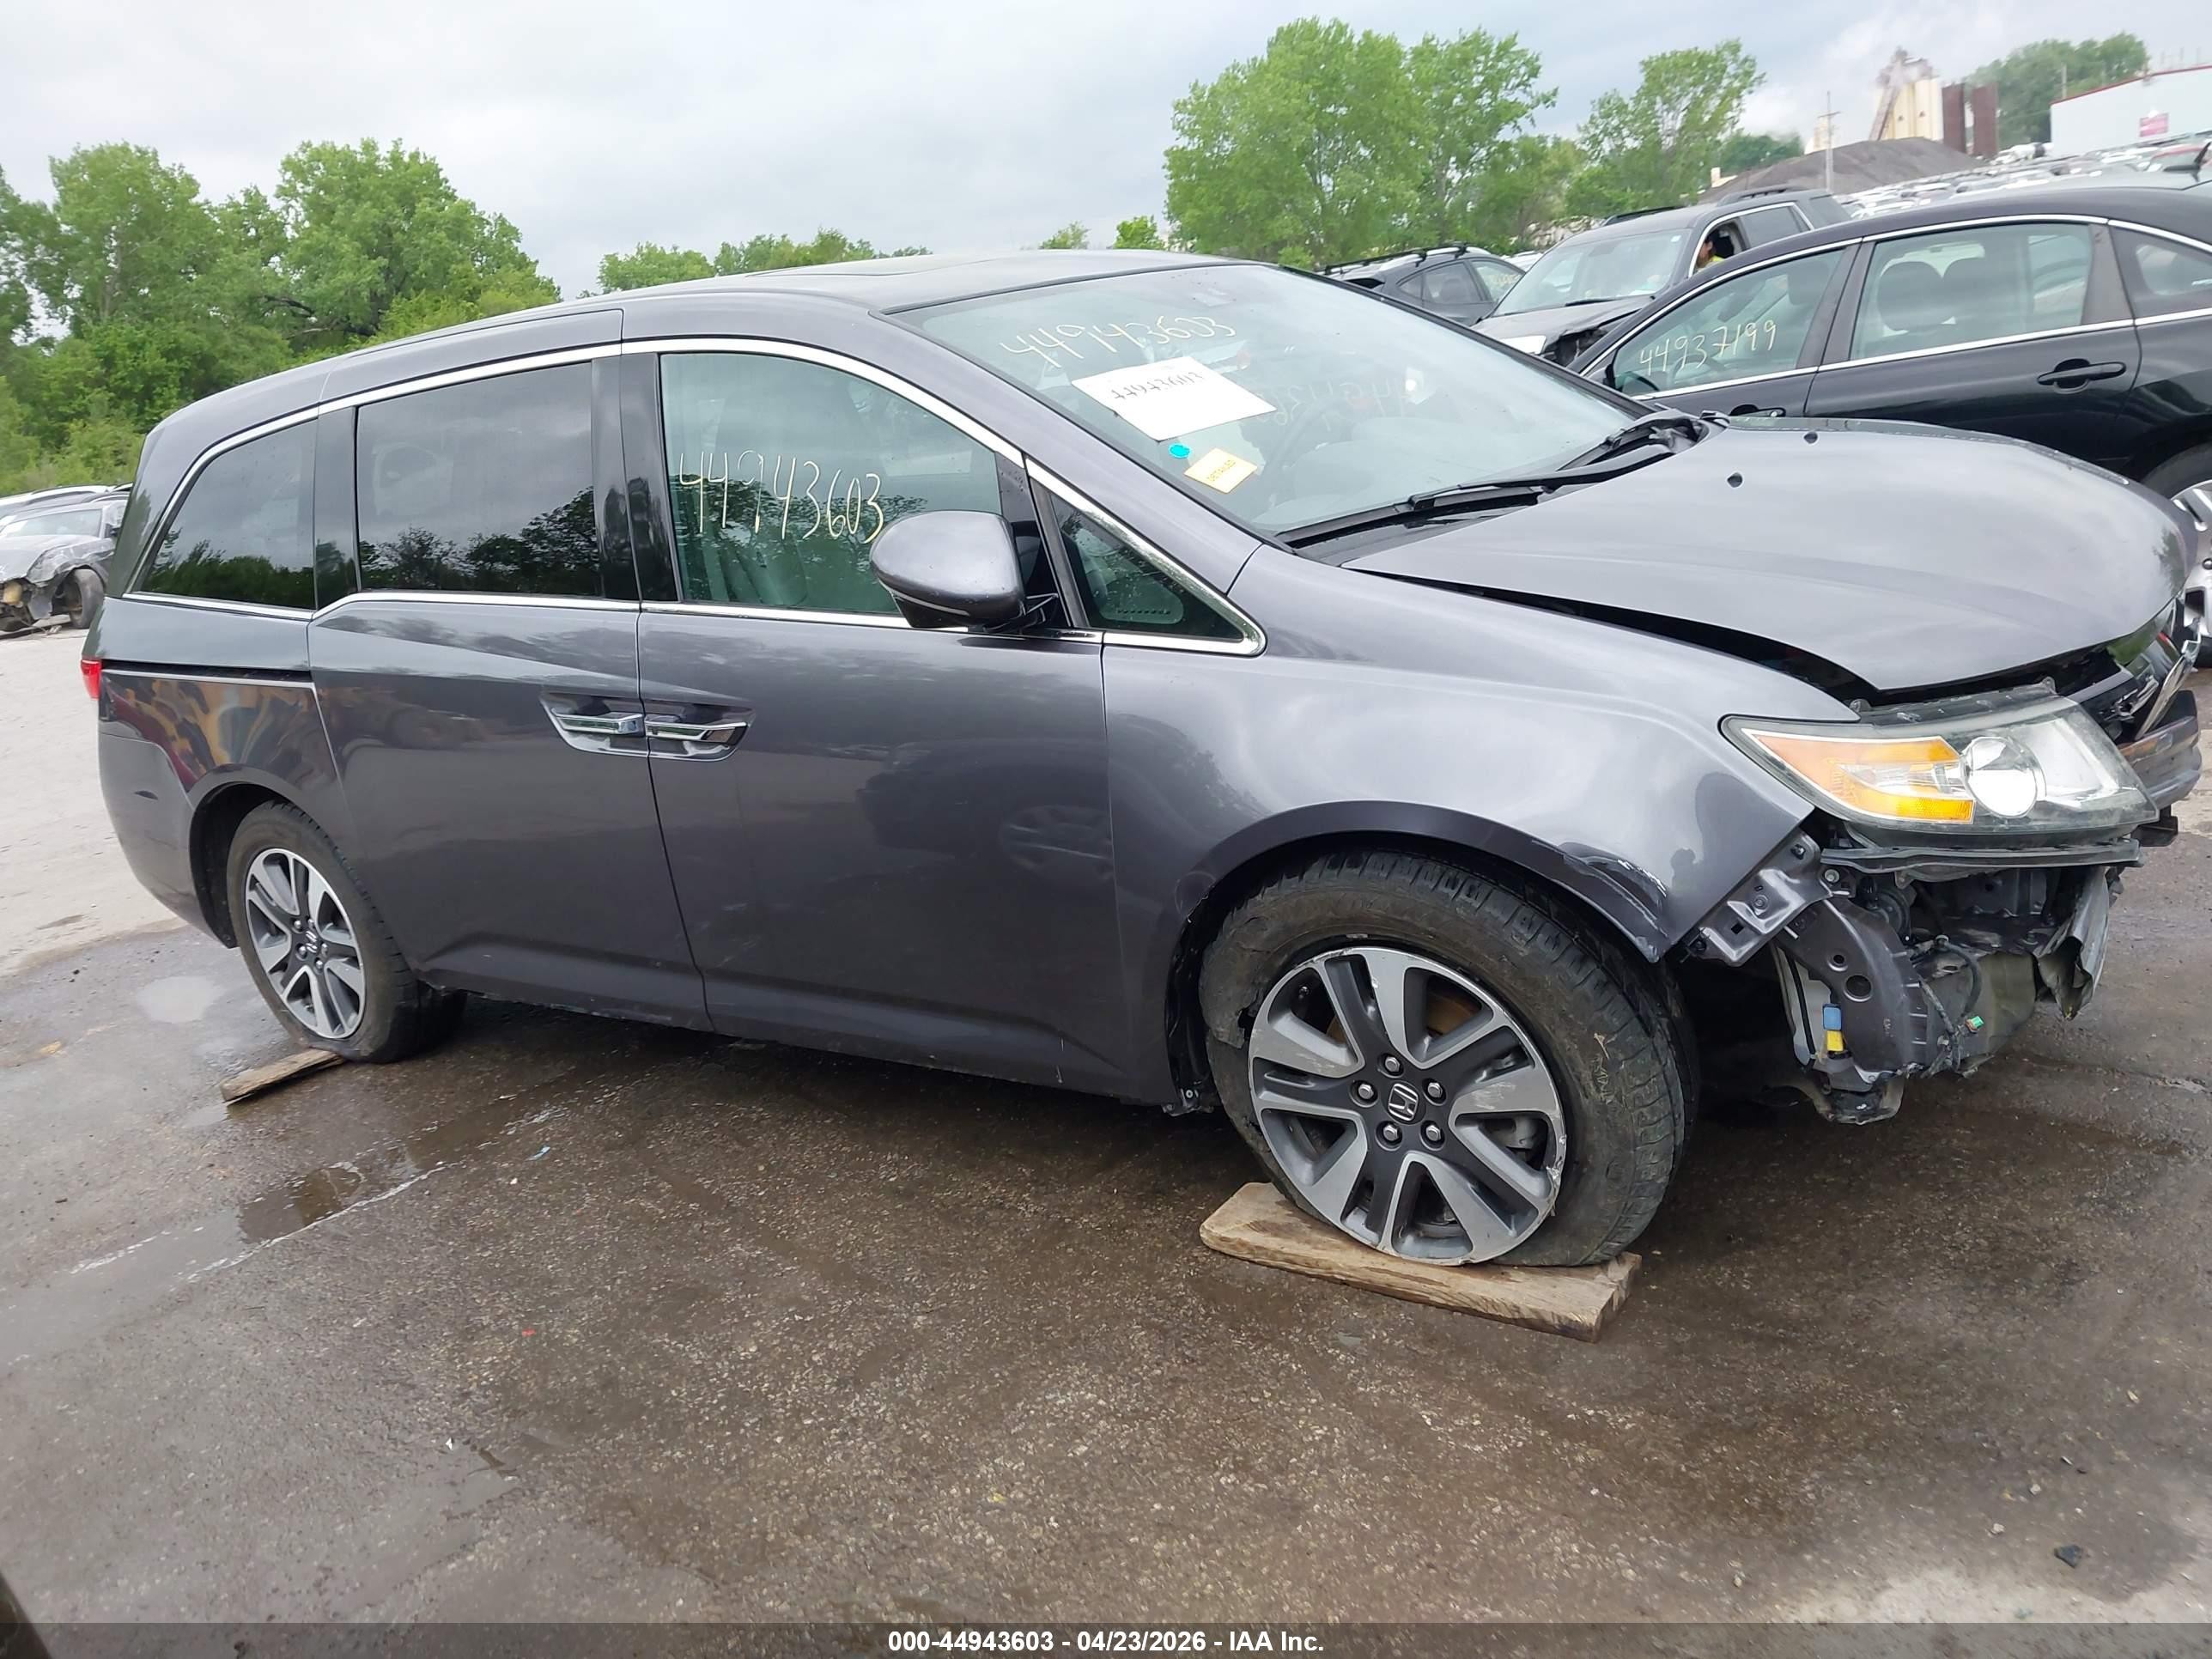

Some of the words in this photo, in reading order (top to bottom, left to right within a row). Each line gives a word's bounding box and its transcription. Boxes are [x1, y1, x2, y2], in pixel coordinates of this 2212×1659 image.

[1000, 316, 1236, 368] 44943603
[1639, 319, 1778, 376] 44937199
[678, 449, 884, 544] 44943603
